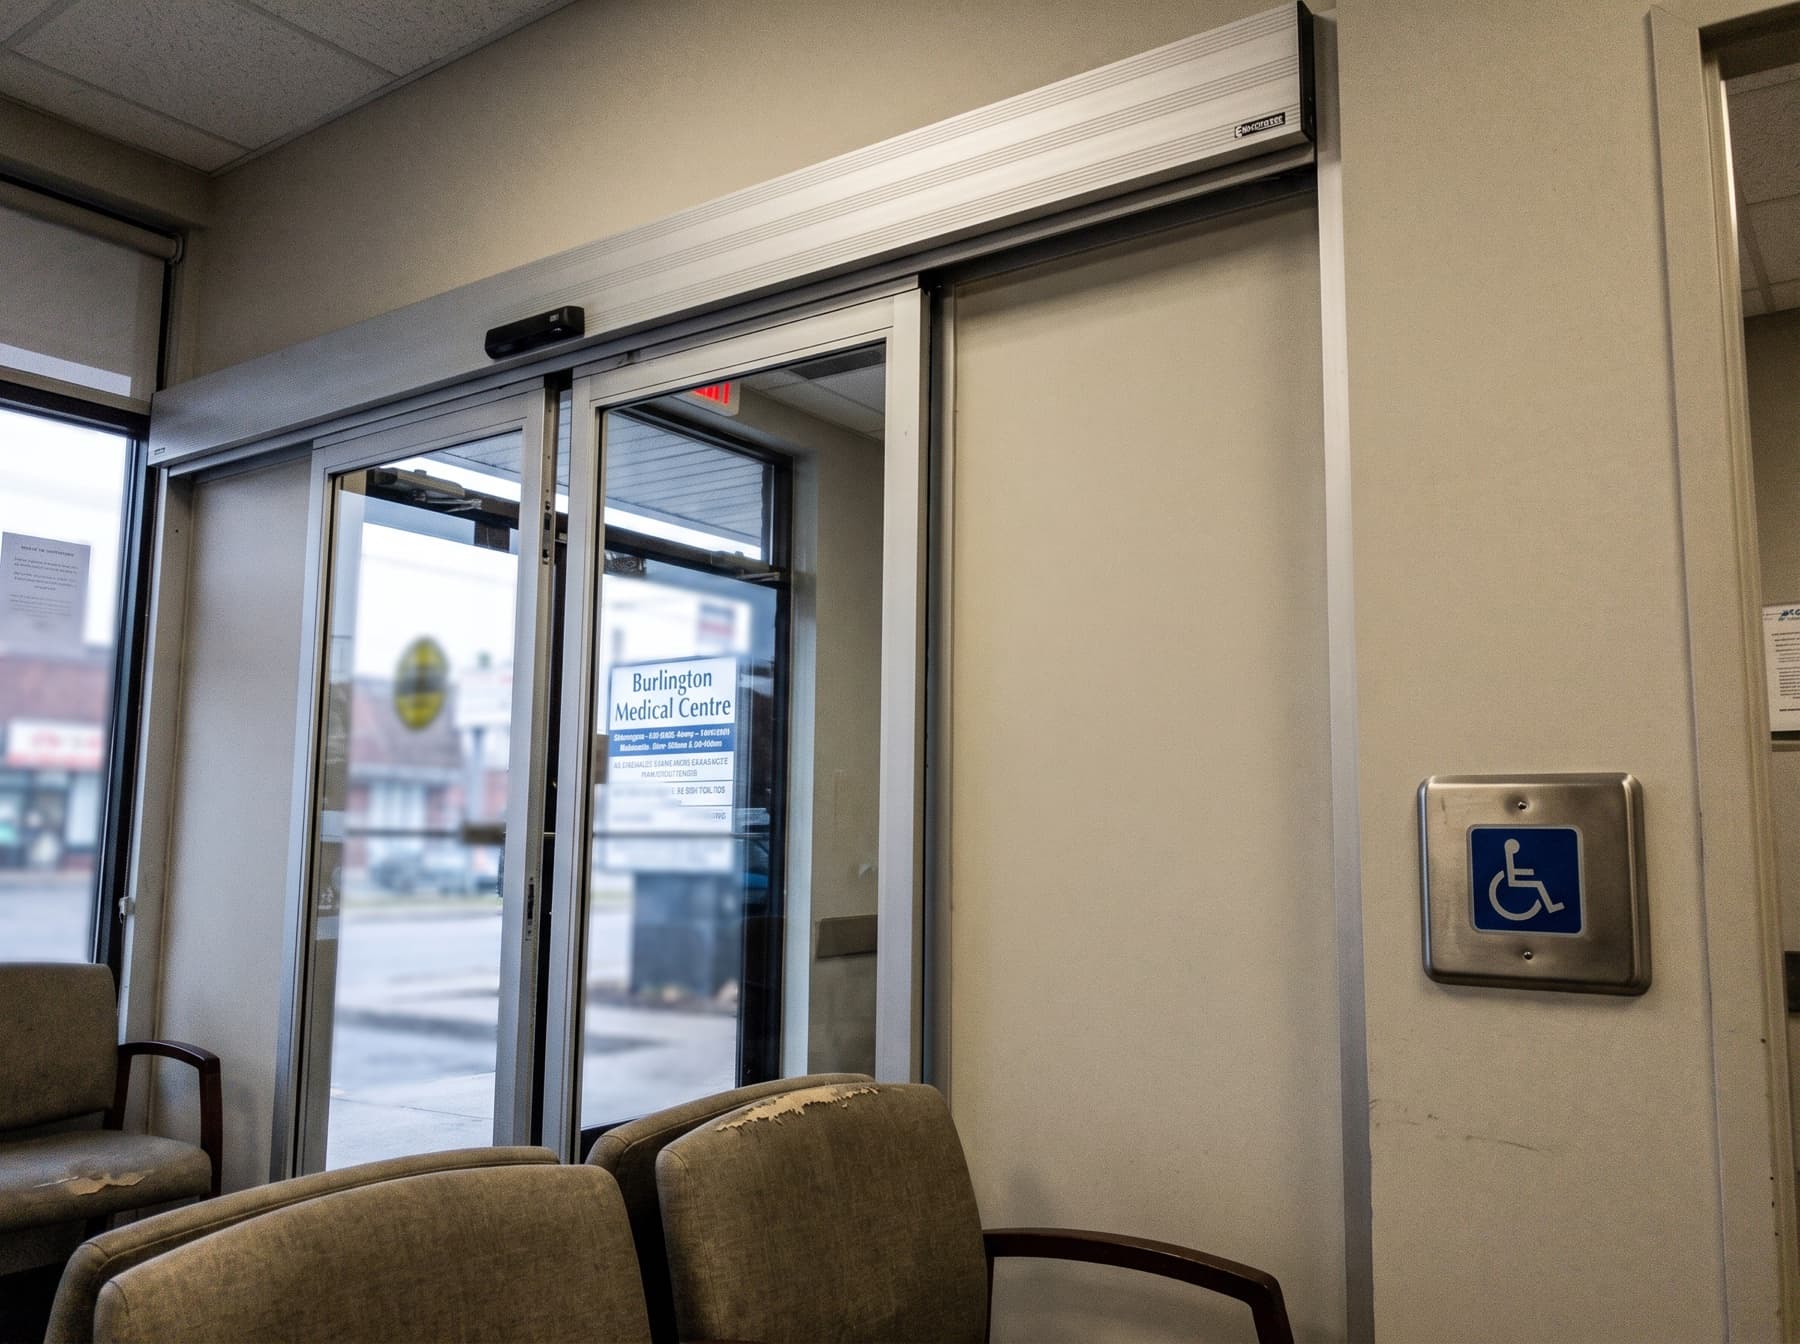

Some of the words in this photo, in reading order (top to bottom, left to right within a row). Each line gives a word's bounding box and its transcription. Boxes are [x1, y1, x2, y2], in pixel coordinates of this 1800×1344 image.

[632, 669, 712, 695] Burlington
[615, 697, 673, 721] Medical
[678, 697, 731, 718] Centre
